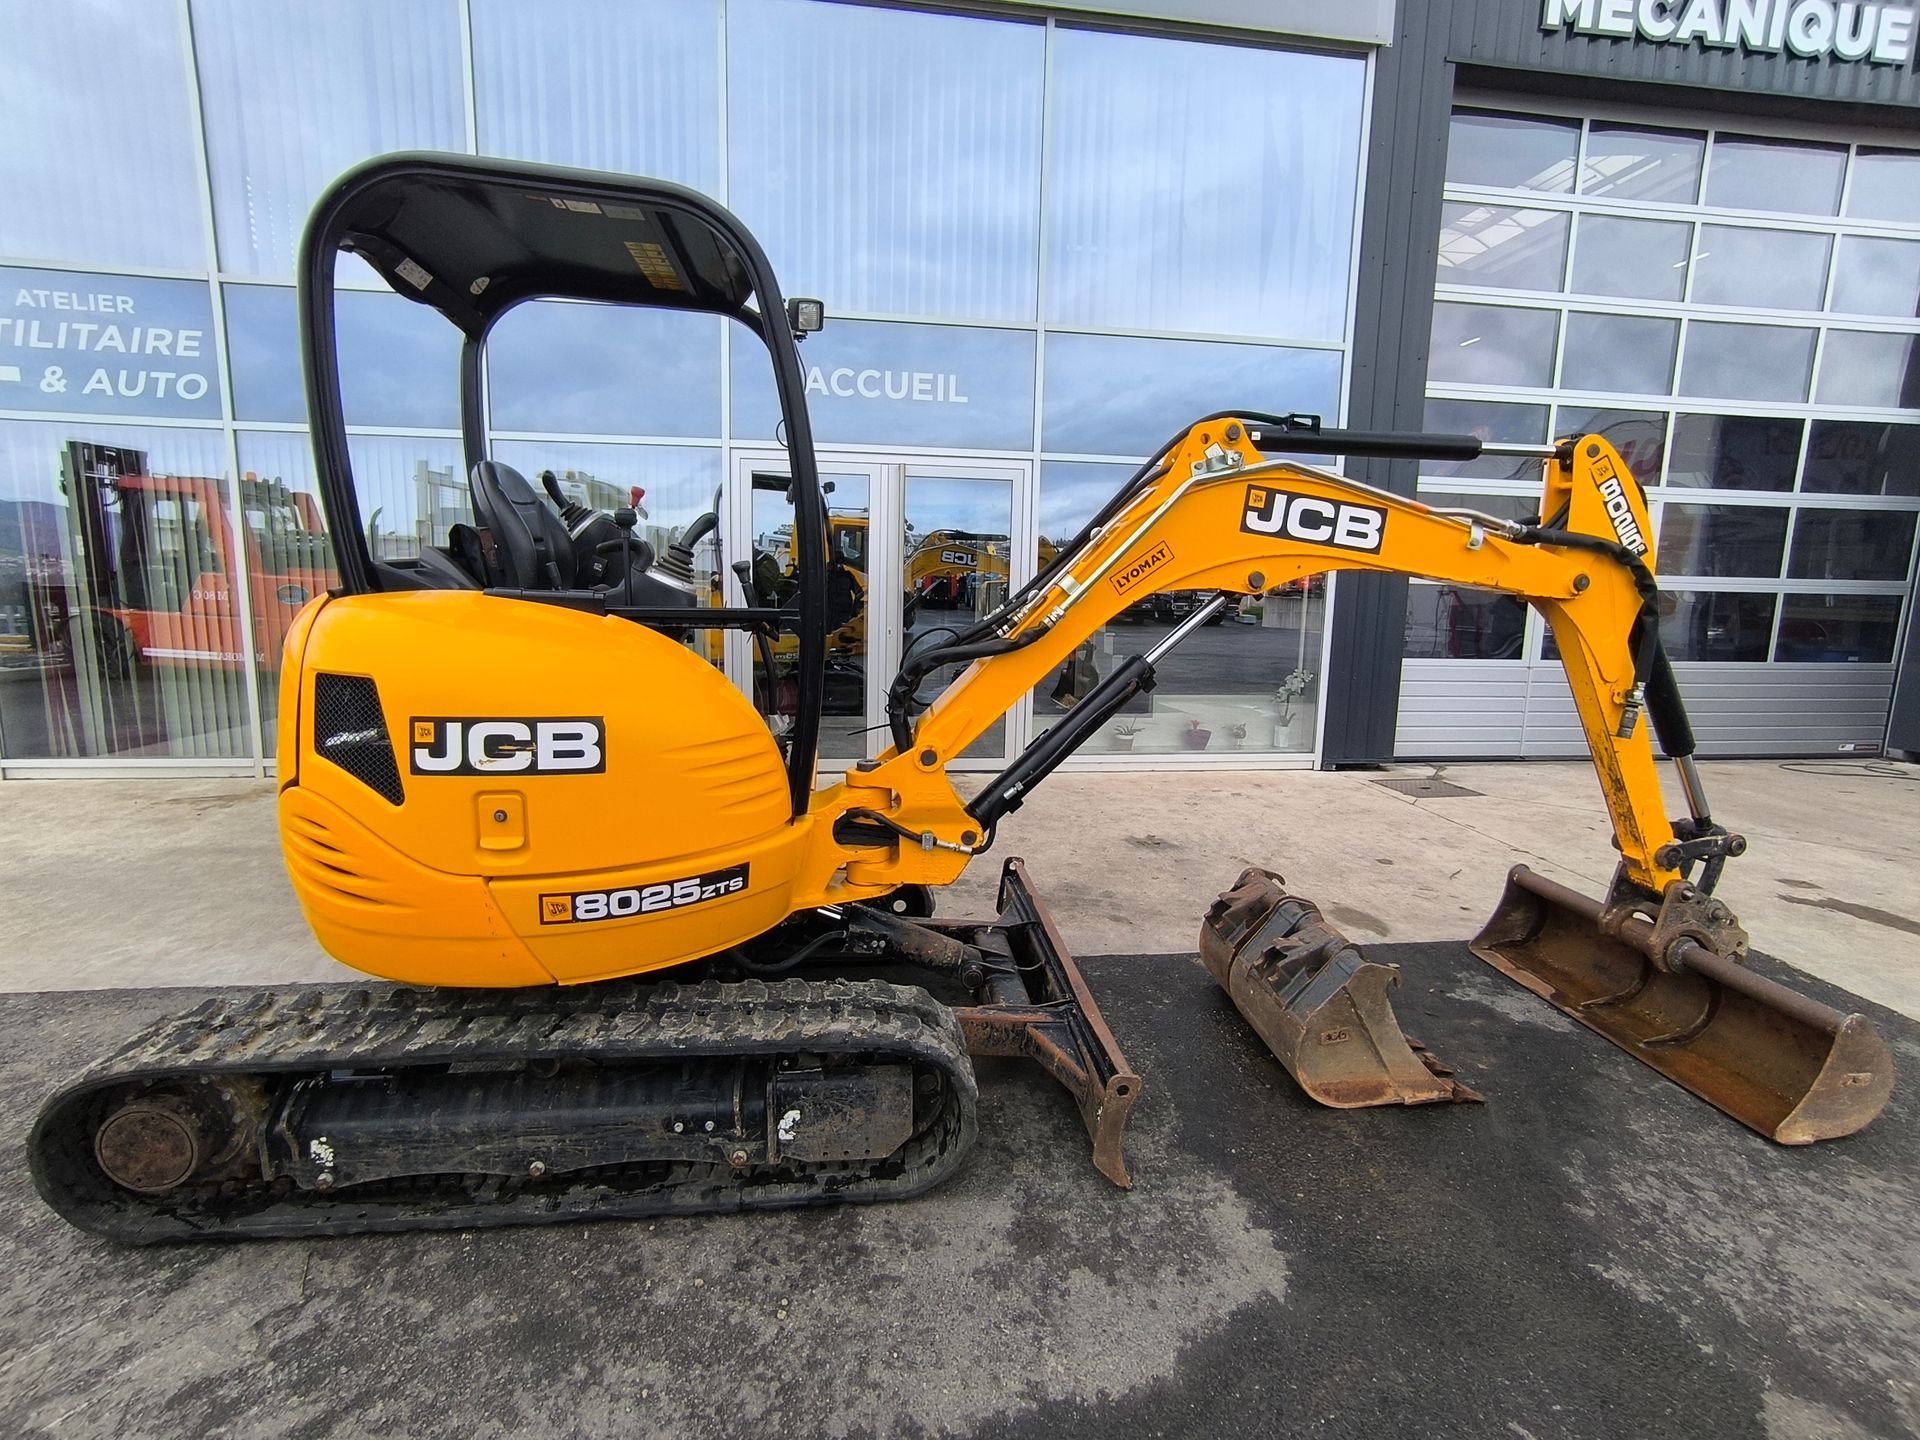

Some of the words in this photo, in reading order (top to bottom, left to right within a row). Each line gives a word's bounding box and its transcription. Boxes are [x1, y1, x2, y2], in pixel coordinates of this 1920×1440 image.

[15, 288, 136, 314] ATELIER
[39, 364, 69, 394] &
[81, 368, 209, 400] AUTO
[804, 366, 969, 403] ACCUEIL
[1245, 493, 1383, 550] JCB
[1115, 547, 1167, 589] LYOMAT
[413, 721, 602, 772] JCB
